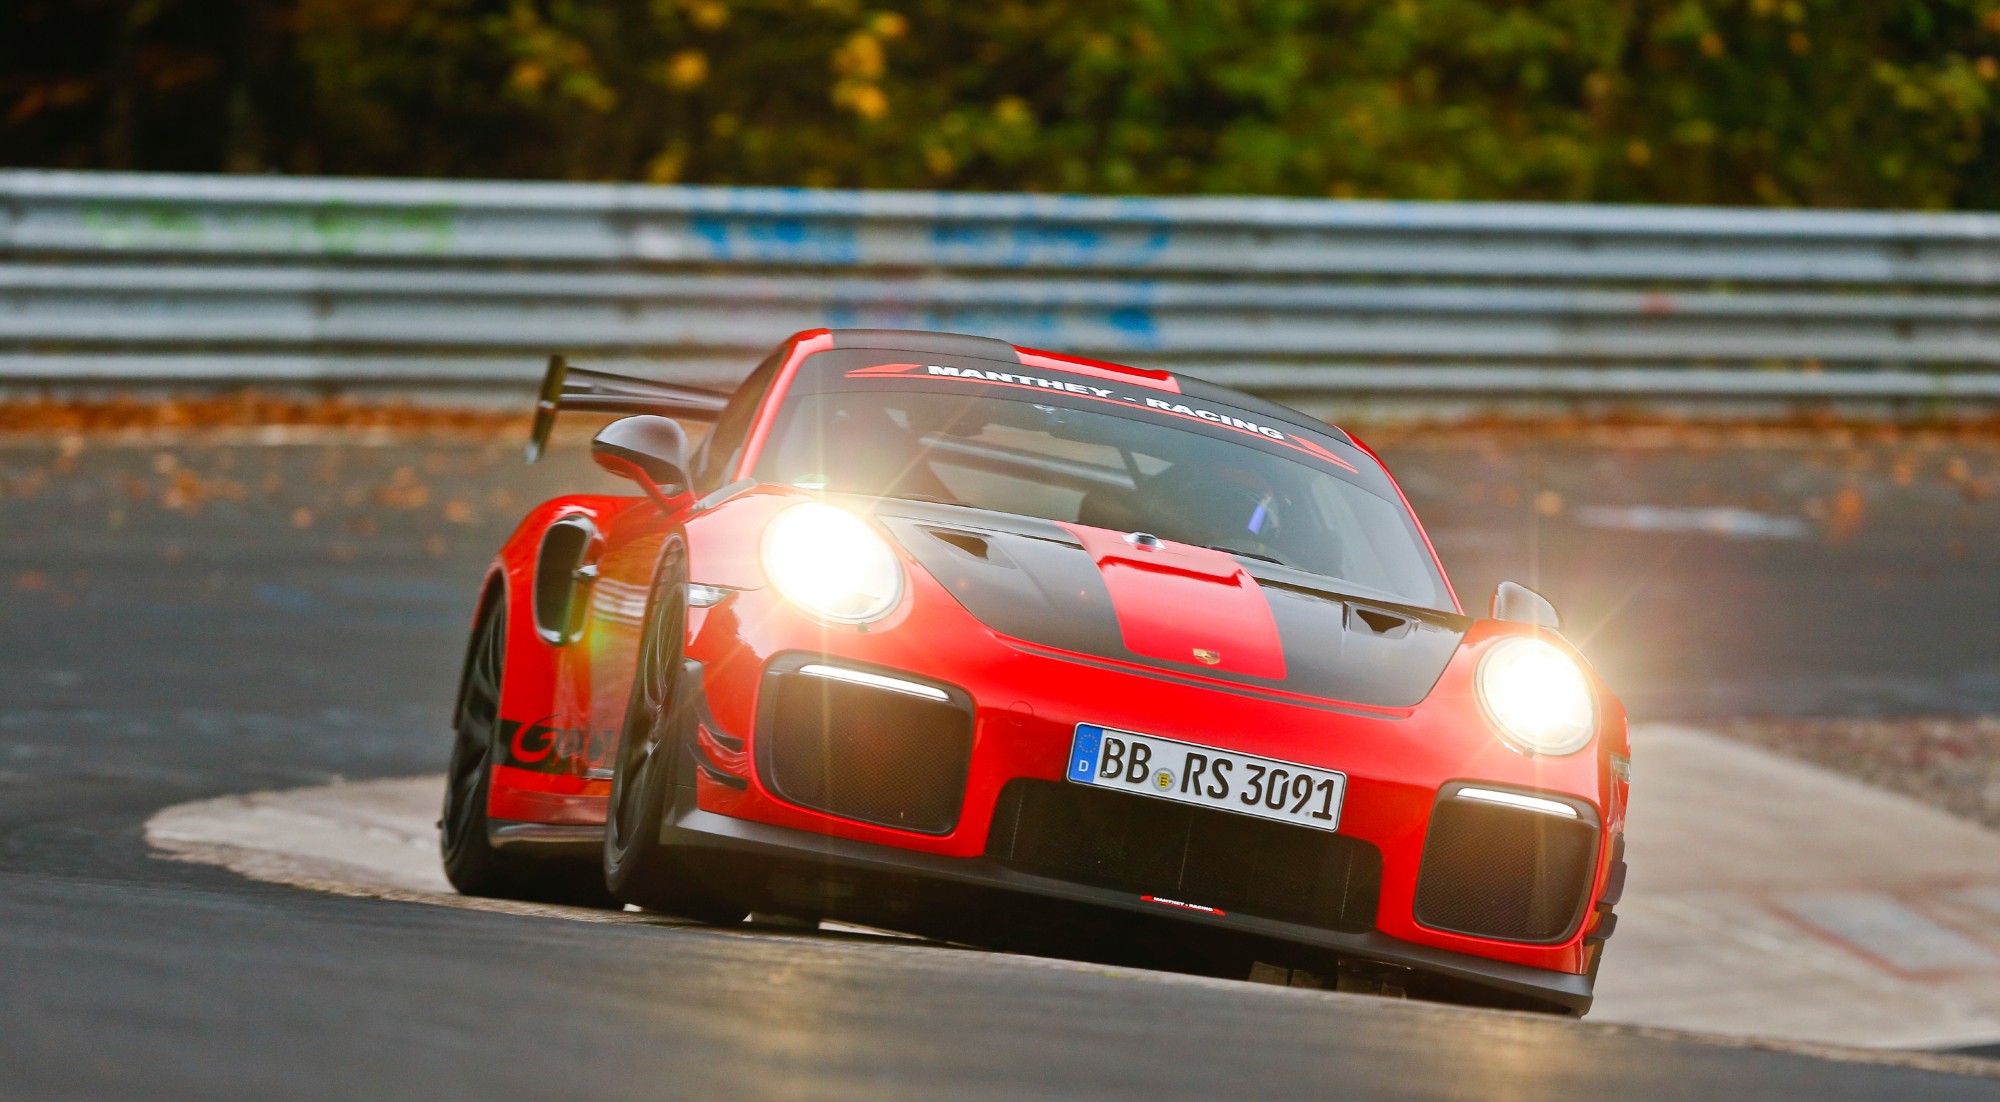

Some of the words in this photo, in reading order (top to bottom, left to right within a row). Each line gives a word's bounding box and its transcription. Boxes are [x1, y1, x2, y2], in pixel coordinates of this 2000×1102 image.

[928, 365, 1113, 398] MANTHEY
[1145, 397, 1286, 441] RACING
[1078, 759, 1089, 772] D
[1099, 737, 1152, 784] BB
[1180, 752, 1233, 799] RS
[1240, 763, 1335, 821] 3091
[1153, 897, 1185, 906] MANTHEY
[1189, 903, 1213, 911] RACING
